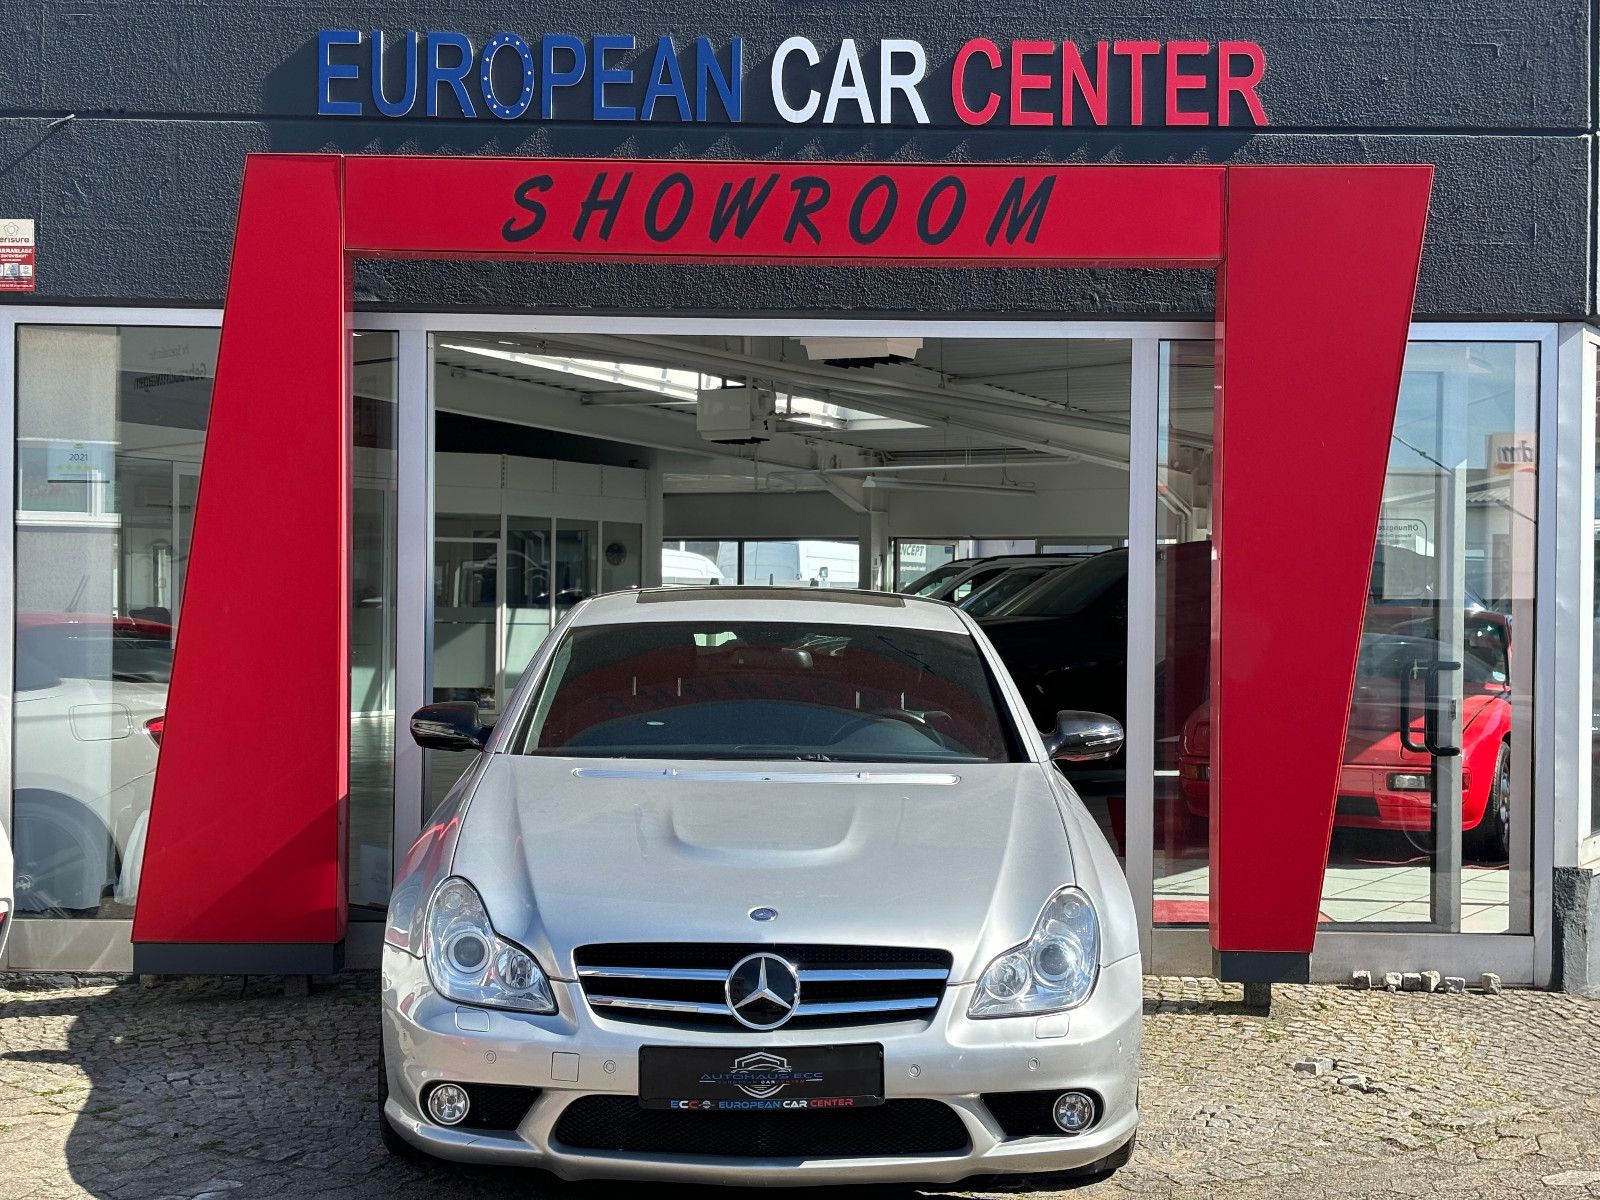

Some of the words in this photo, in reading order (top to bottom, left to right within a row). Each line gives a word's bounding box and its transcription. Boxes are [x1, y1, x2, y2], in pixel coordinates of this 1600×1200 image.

[318, 29, 743, 123] EUROPEAN
[771, 36, 931, 125] CAR
[951, 38, 1270, 126] CENTER
[501, 171, 1057, 247] SHOWROOM
[0, 236, 30, 244] erisure
[68, 453, 89, 462] 2021
[900, 544, 925, 556] NCEPT
[700, 1072, 790, 1080] AUTOHAUS
[793, 1071, 823, 1079] ECC
[670, 1100, 699, 1109] ECC
[718, 1100, 780, 1109] EUROPEAN
[782, 1100, 808, 1108] CAR
[809, 1098, 854, 1108] CENTER
